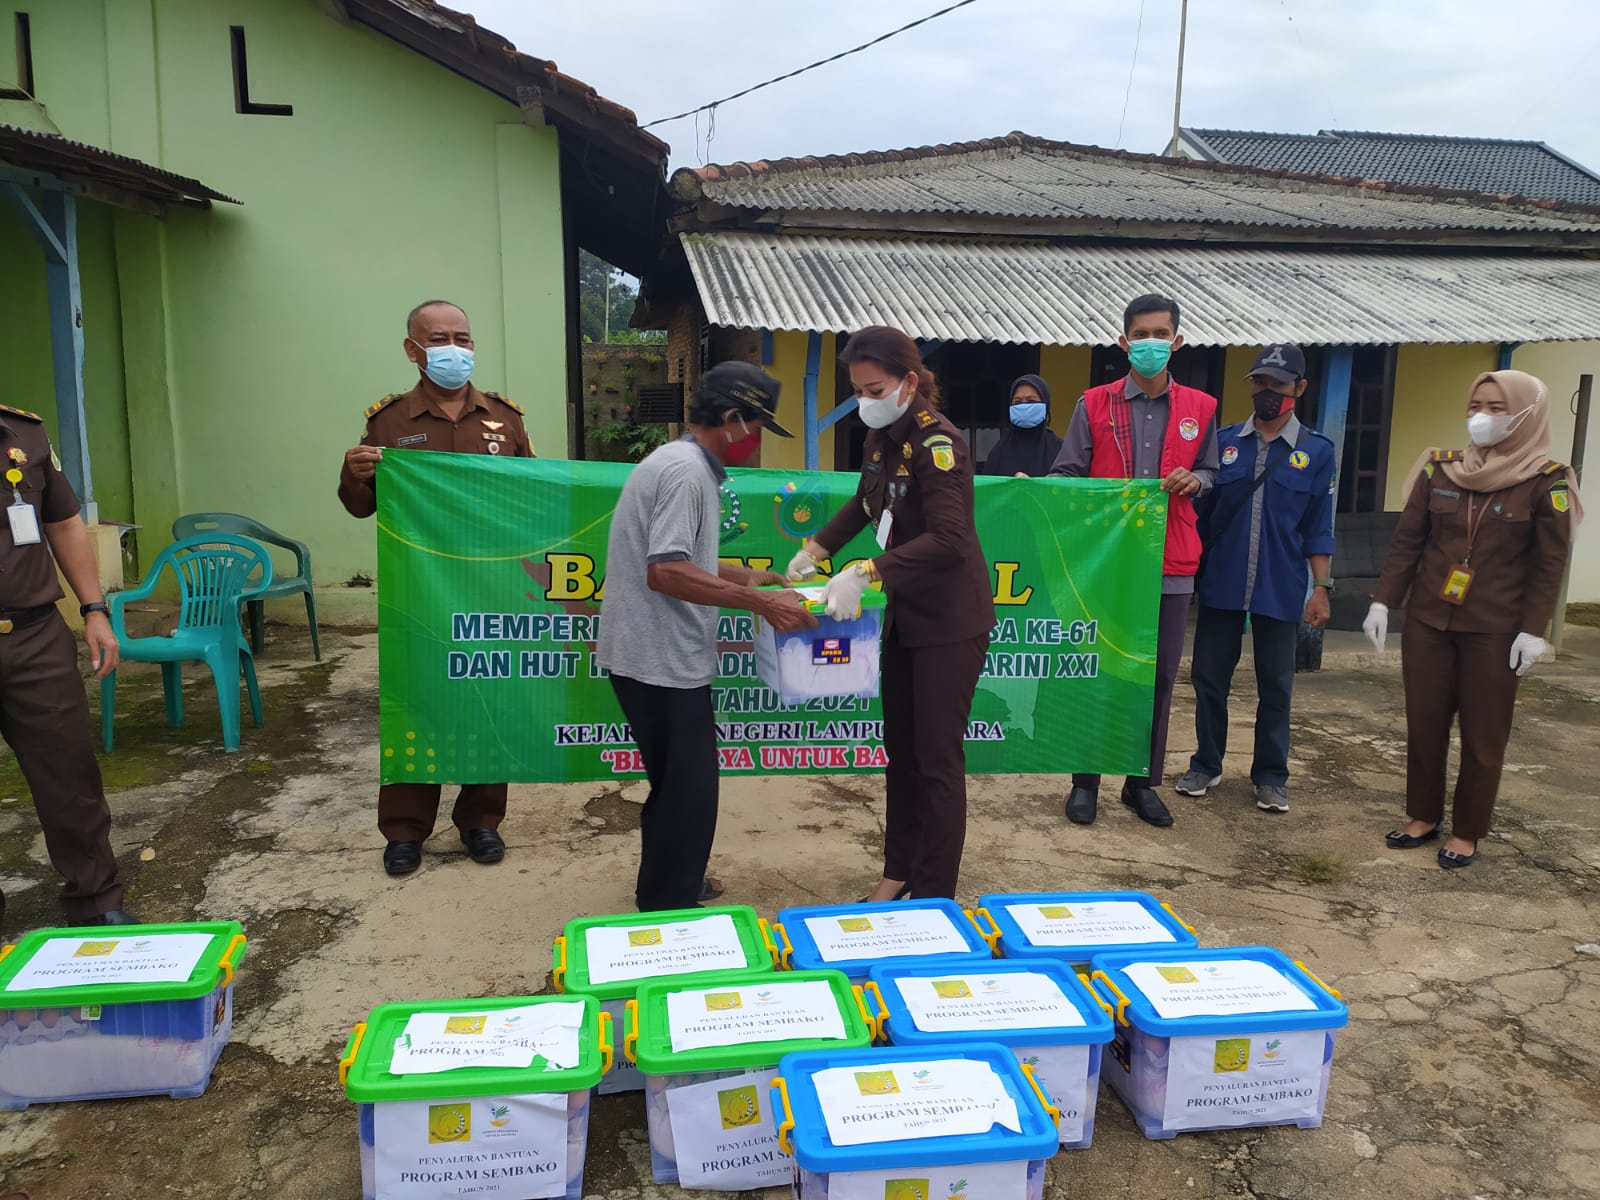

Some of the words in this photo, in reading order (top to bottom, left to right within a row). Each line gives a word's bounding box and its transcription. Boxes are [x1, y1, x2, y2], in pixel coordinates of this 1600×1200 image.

[1026, 618, 1098, 645] KE-61
[448, 651, 511, 679] DAN
[520, 651, 582, 679] HUT
[1055, 652, 1098, 679] XXI
[760, 746, 849, 768] UNTUK
[1035, 926, 1094, 935] PROGRAM
[1095, 925, 1151, 933] SEMBAKO
[830, 940, 889, 950] PROGRAM
[891, 935, 948, 945] SEMBAKO
[609, 955, 673, 968] PROGRAM
[675, 949, 736, 962] SEMBAKO
[32, 966, 106, 976] PROGRAM
[109, 962, 179, 973] SEMBAKO
[1161, 994, 1224, 1002] PROGRAM
[1226, 990, 1287, 1000] SEMBAKO
[925, 1009, 992, 1019] PROGRAM
[994, 1004, 1059, 1015] SEMBAKO
[684, 1021, 754, 1033] PROGRAM
[757, 1016, 825, 1027] SEMBAKO
[1203, 1081, 1260, 1093] PENYALURAN
[1262, 1077, 1300, 1088] BANTUAN
[1186, 1094, 1250, 1108] PROGRAM
[1253, 1087, 1313, 1104] SEMBAKO
[841, 1107, 919, 1124] PROGRAM
[418, 1153, 488, 1166] PENYALURAN
[491, 1149, 539, 1162] BANTUAN
[702, 1152, 774, 1174] PROGRAM
[401, 1169, 478, 1184] PROGRAM
[482, 1161, 558, 1180] SEMBAKO
